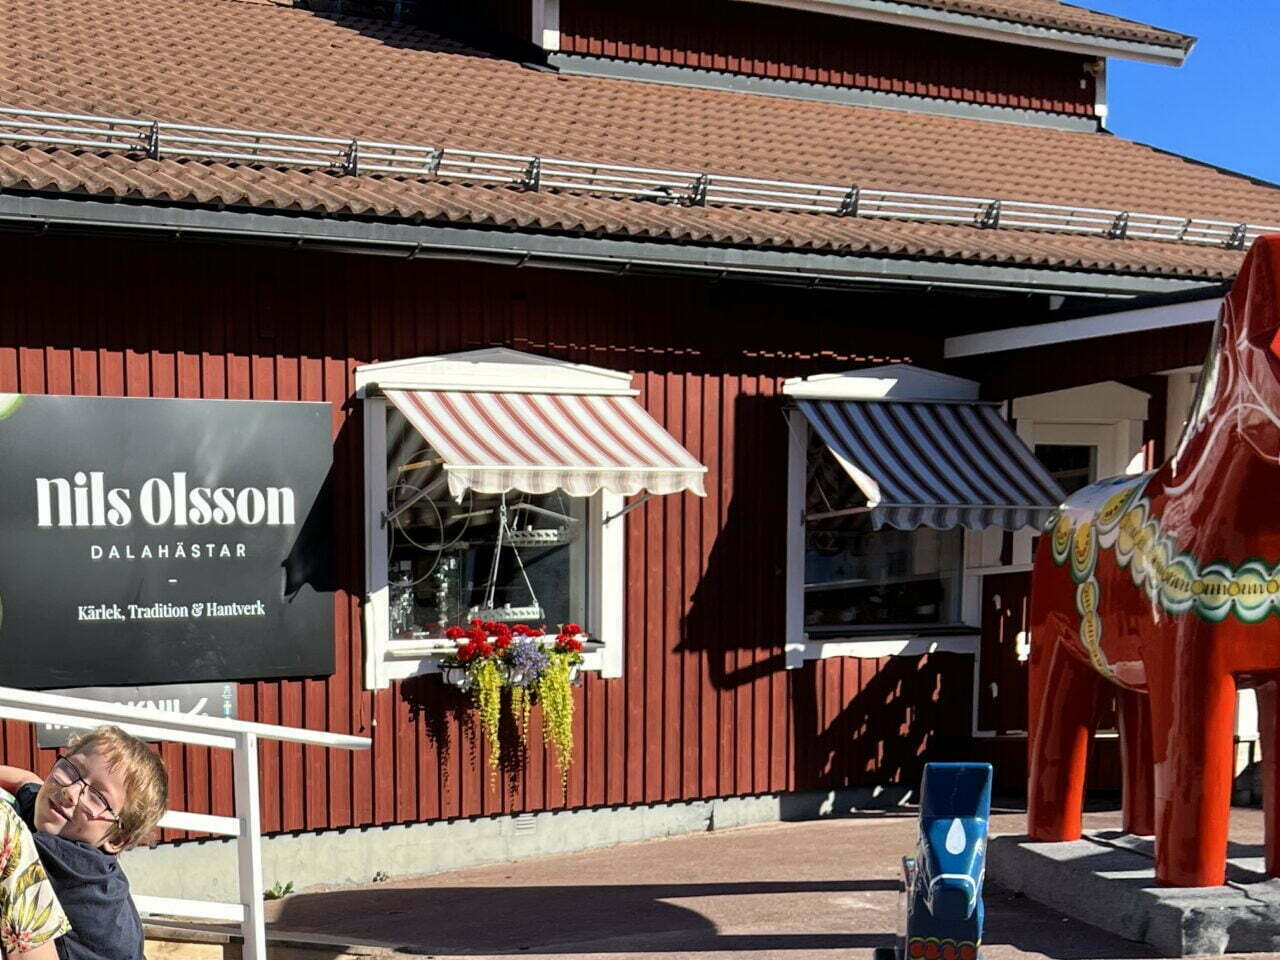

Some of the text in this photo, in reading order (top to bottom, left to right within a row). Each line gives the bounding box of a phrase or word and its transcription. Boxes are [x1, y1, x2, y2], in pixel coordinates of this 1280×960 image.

[35, 471, 296, 527] Nils Olsson
[90, 542, 247, 560] DALAHÄSTAR
[77, 600, 266, 622] Kärlek, Tradition & Hantverk
